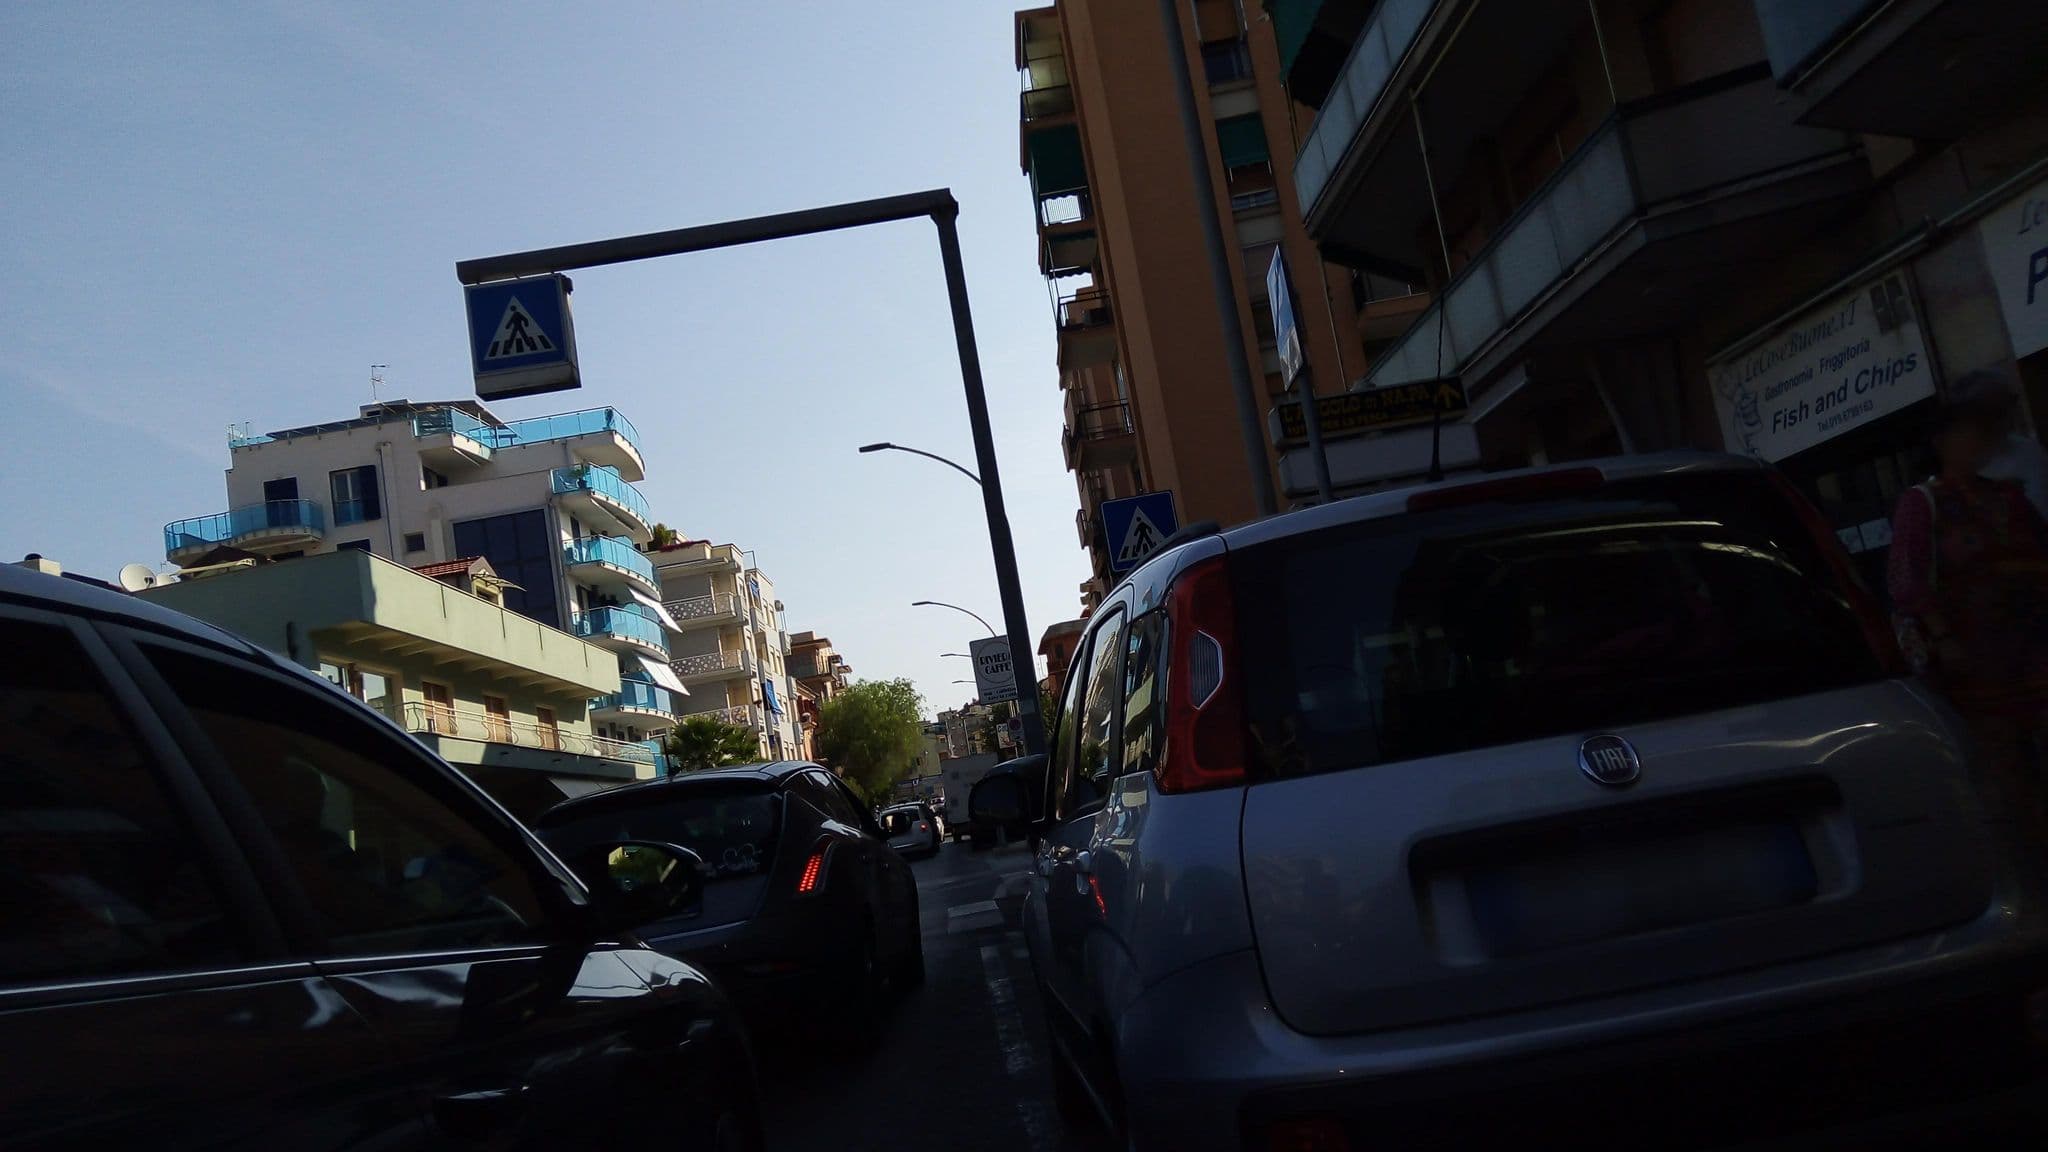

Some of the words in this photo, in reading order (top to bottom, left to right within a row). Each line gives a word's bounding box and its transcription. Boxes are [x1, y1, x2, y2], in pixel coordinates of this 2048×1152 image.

[1765, 367, 1814, 402] Gastronomia
[1819, 337, 1871, 373] Friggitoria
[1772, 400, 1809, 434] Fish
[1815, 378, 1848, 415] and
[1855, 351, 1917, 395] Chips
[1591, 746, 1629, 771] FIAT
